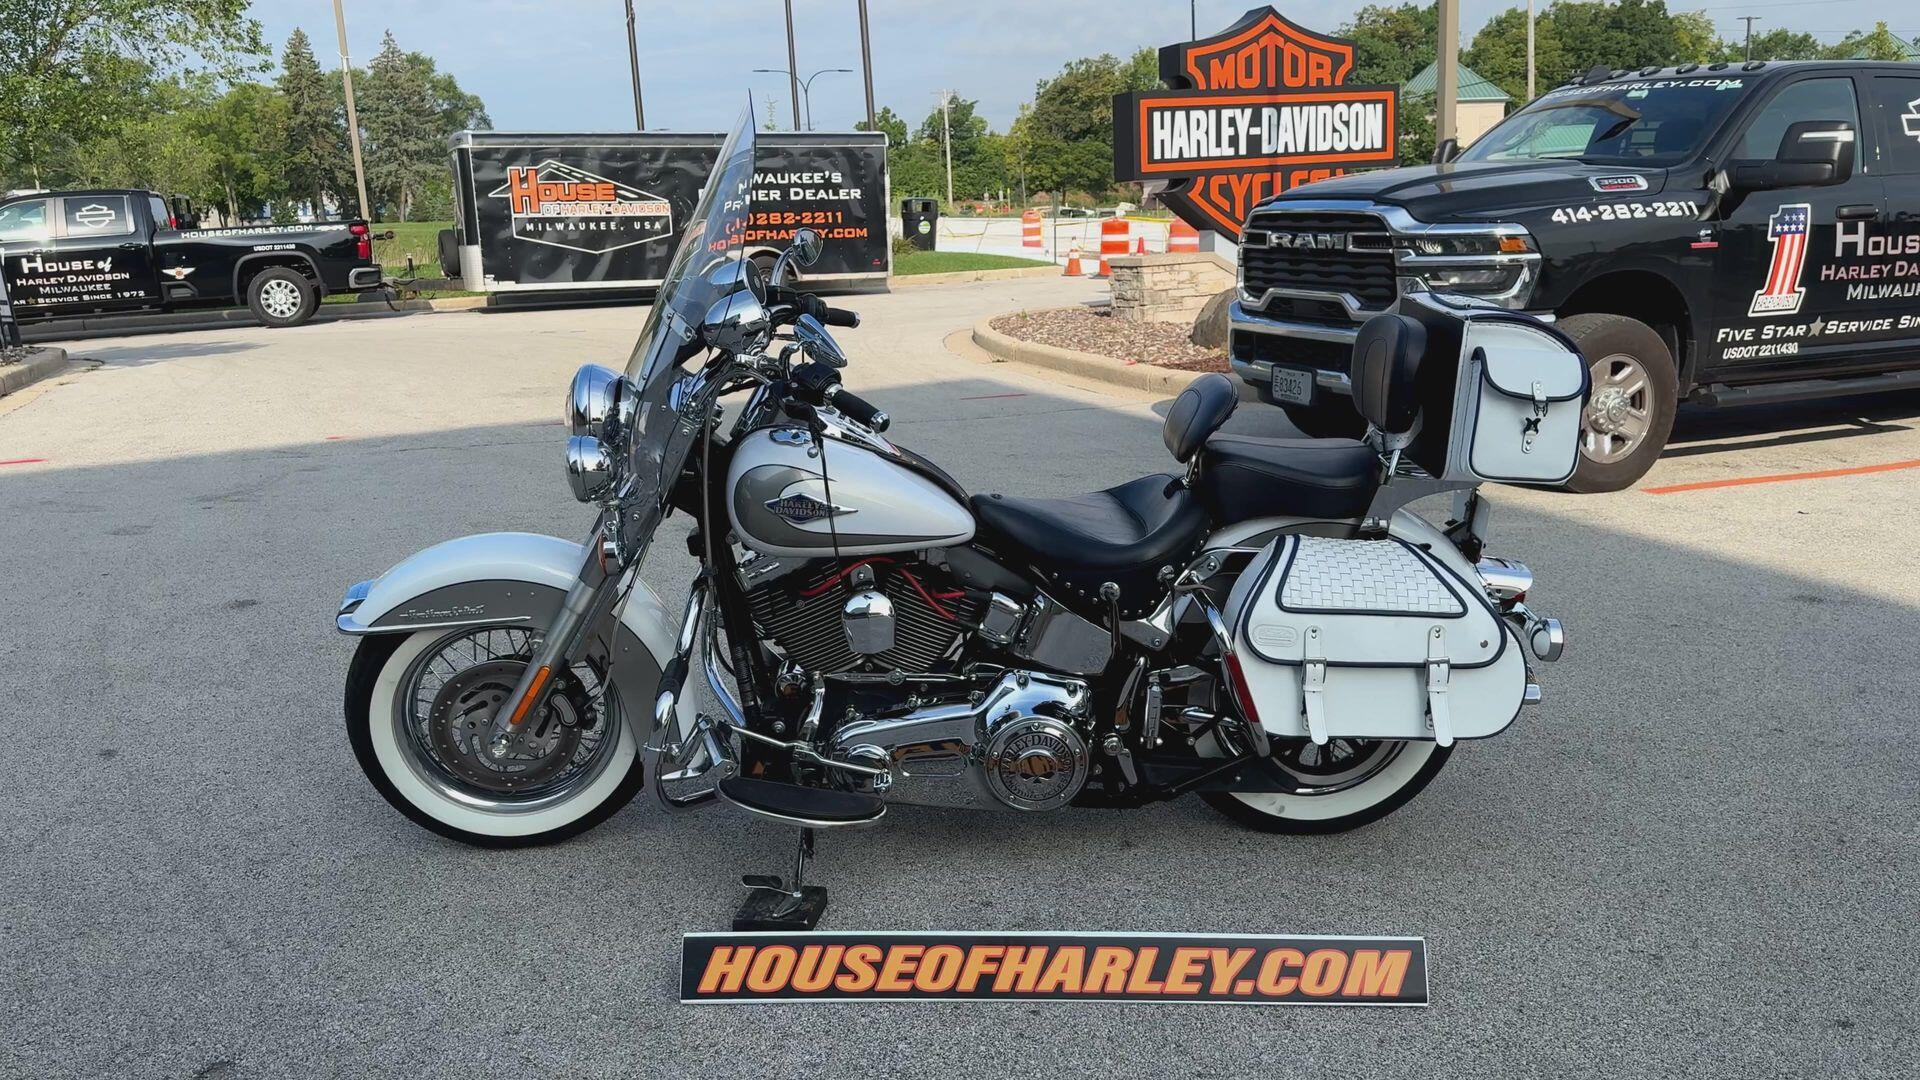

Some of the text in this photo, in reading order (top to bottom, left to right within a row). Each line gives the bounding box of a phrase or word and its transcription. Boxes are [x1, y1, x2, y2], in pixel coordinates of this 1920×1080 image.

[1210, 31, 1332, 90] MOTOR
[1152, 102, 1383, 160] HARLEY-DAVIDSON
[510, 168, 615, 214] HOUSE
[790, 187, 862, 201] DEALER
[543, 202, 670, 215] OF HARLEY-DAVIDSON
[1551, 201, 1700, 224] 414-282-2211
[181, 225, 313, 239] HOUSEOFHARLEY.COM
[634, 221, 661, 230] USA
[1269, 231, 1345, 249] RAM
[21, 256, 112, 274] HOUSE of
[1820, 264, 1892, 280] HARLEY
[16, 272, 130, 287] HARLEY DAVIDSON
[37, 296, 79, 304] SERVICE
[82, 293, 112, 301] SINCE
[117, 290, 146, 299] 1972
[40, 283, 112, 295] MILWAUKEE
[1717, 328, 1756, 343] FIVE
[1761, 324, 1807, 339] STAR
[1824, 320, 1894, 335] SERVICE
[1722, 342, 1799, 360] USDOT 2211430
[775, 506, 826, 517] DAVIDSON
[696, 944, 1412, 997] HOUSEOFHARLEY.COM
